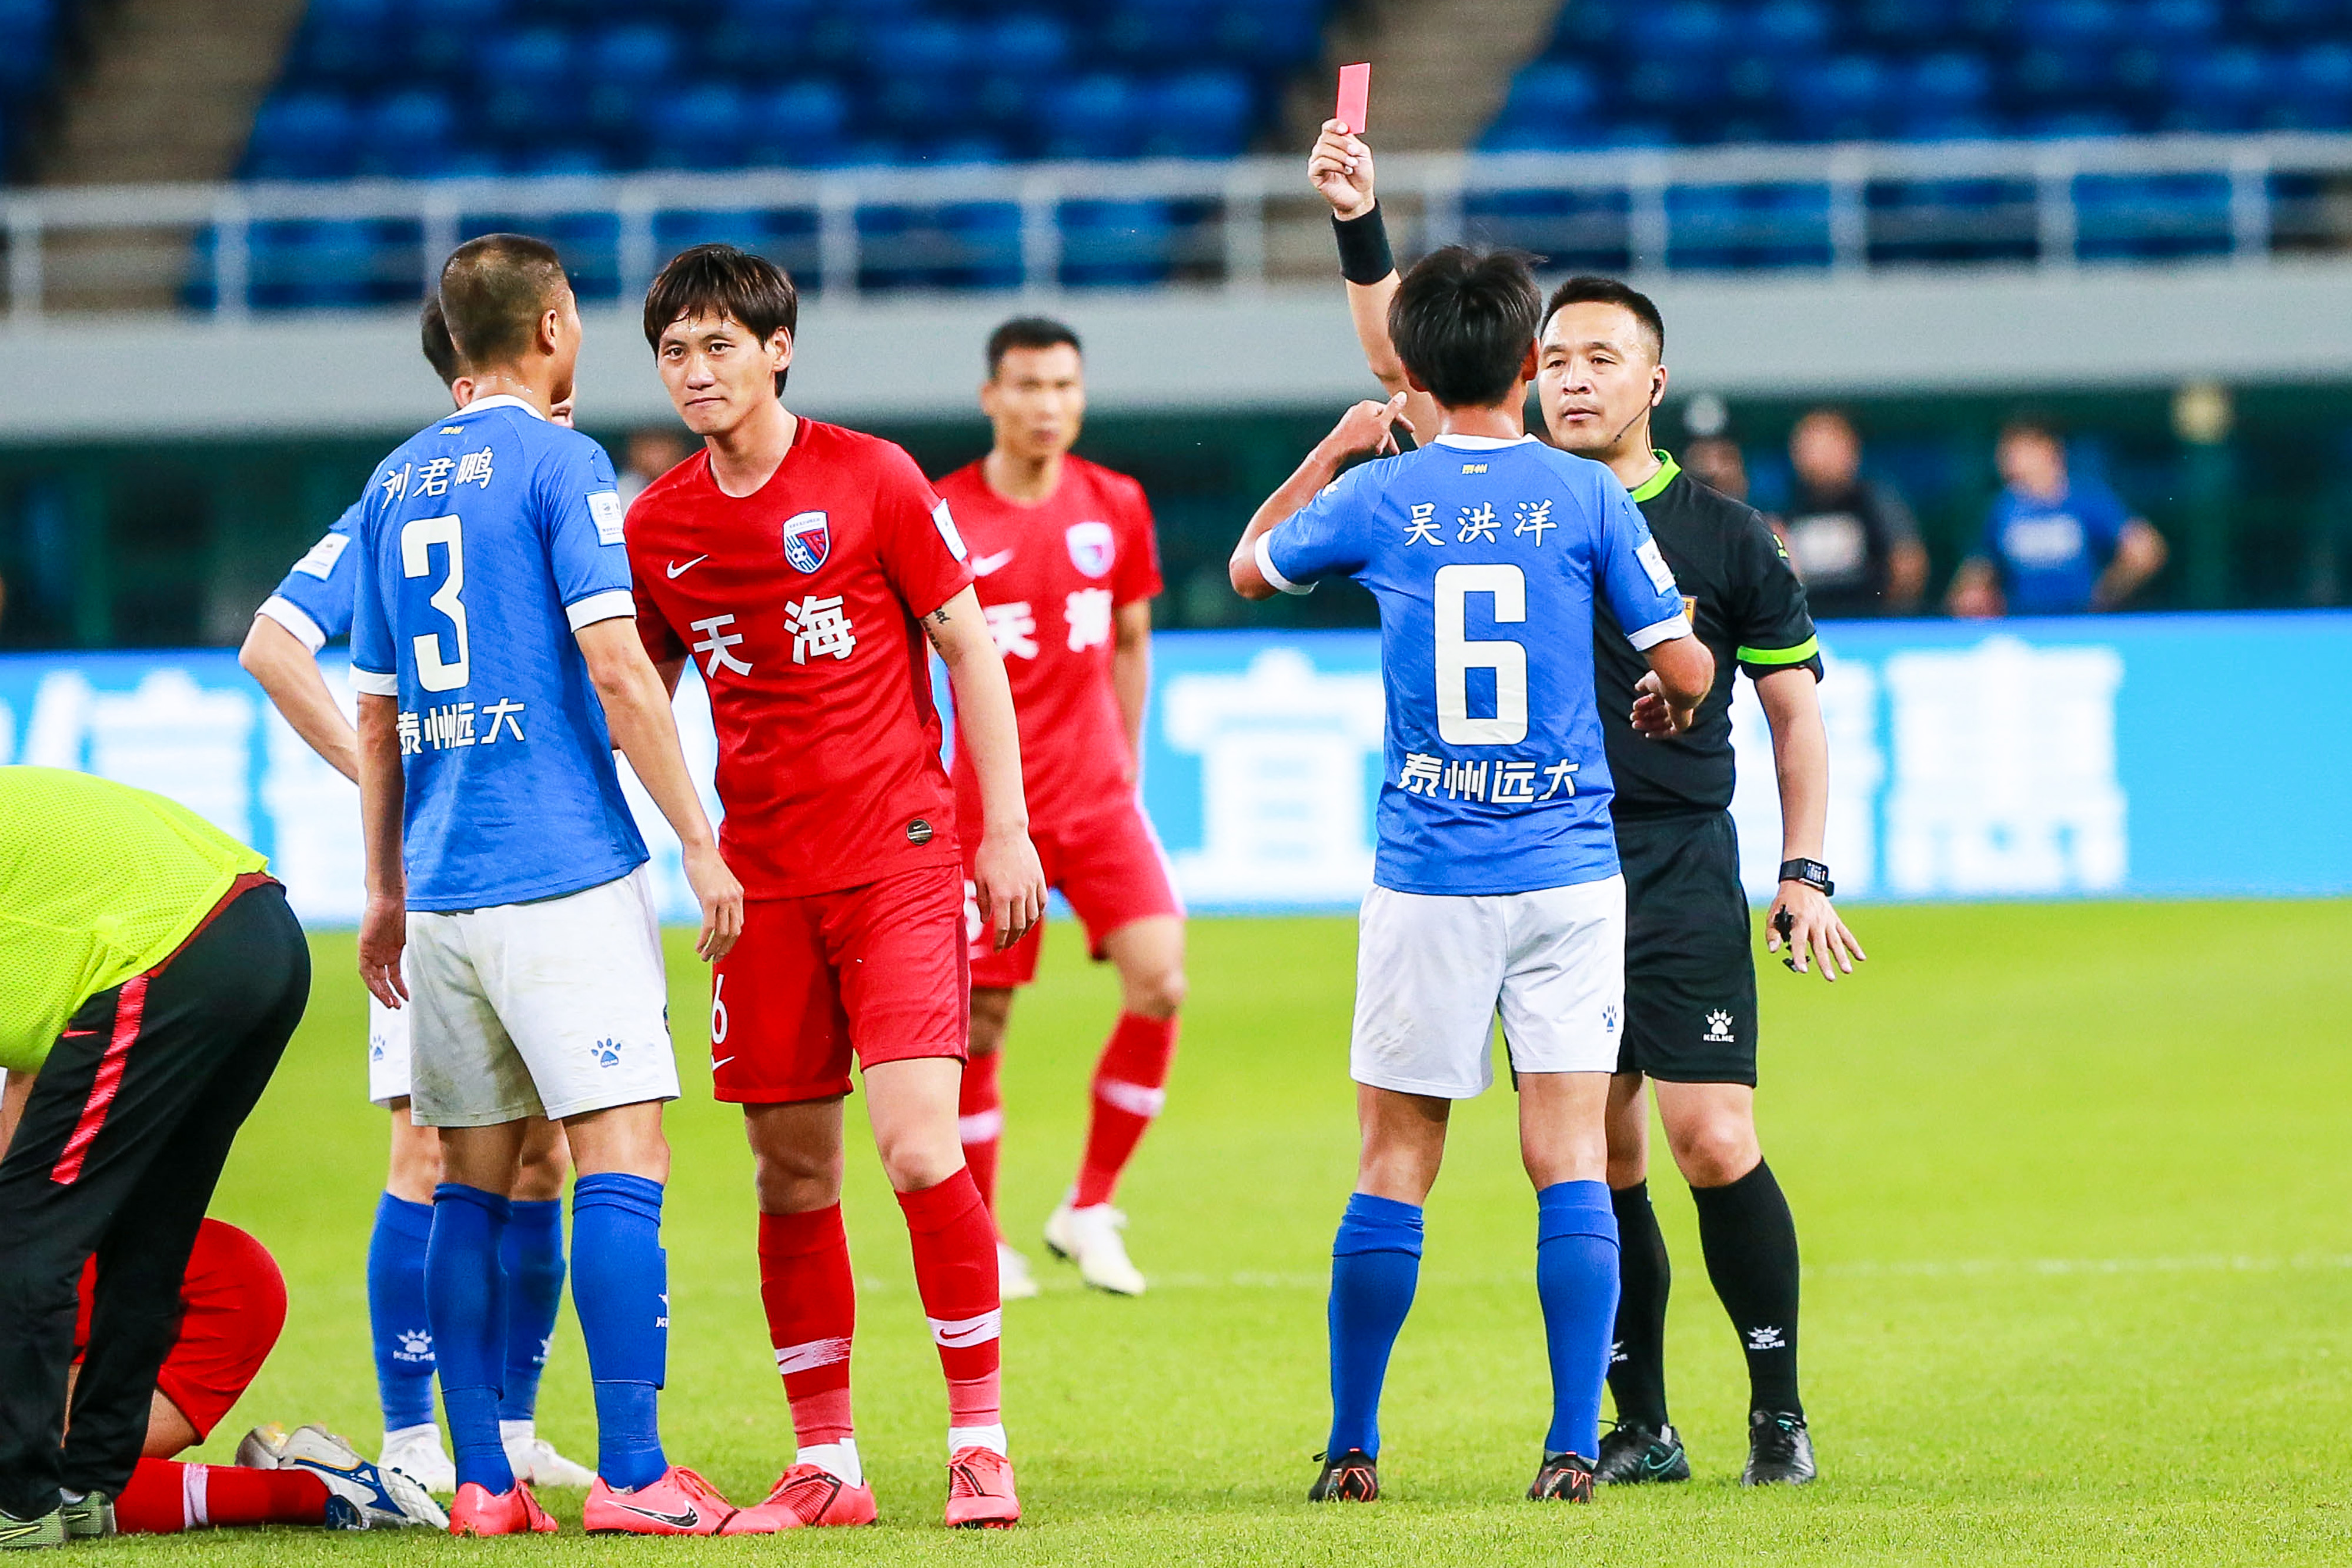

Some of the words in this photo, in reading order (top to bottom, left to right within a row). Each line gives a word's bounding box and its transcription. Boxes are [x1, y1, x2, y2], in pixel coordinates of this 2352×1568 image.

[380, 446, 494, 510] 刘君鹏
[1402, 498, 1558, 548] 吴洪洋
[401, 514, 470, 693] 3
[690, 594, 857, 679] 天海
[1434, 563, 1528, 746] 6
[397, 697, 525, 756] 泰州远大
[1397, 752, 1580, 804] 泰州远大
[1703, 1034, 1735, 1042] KELME
